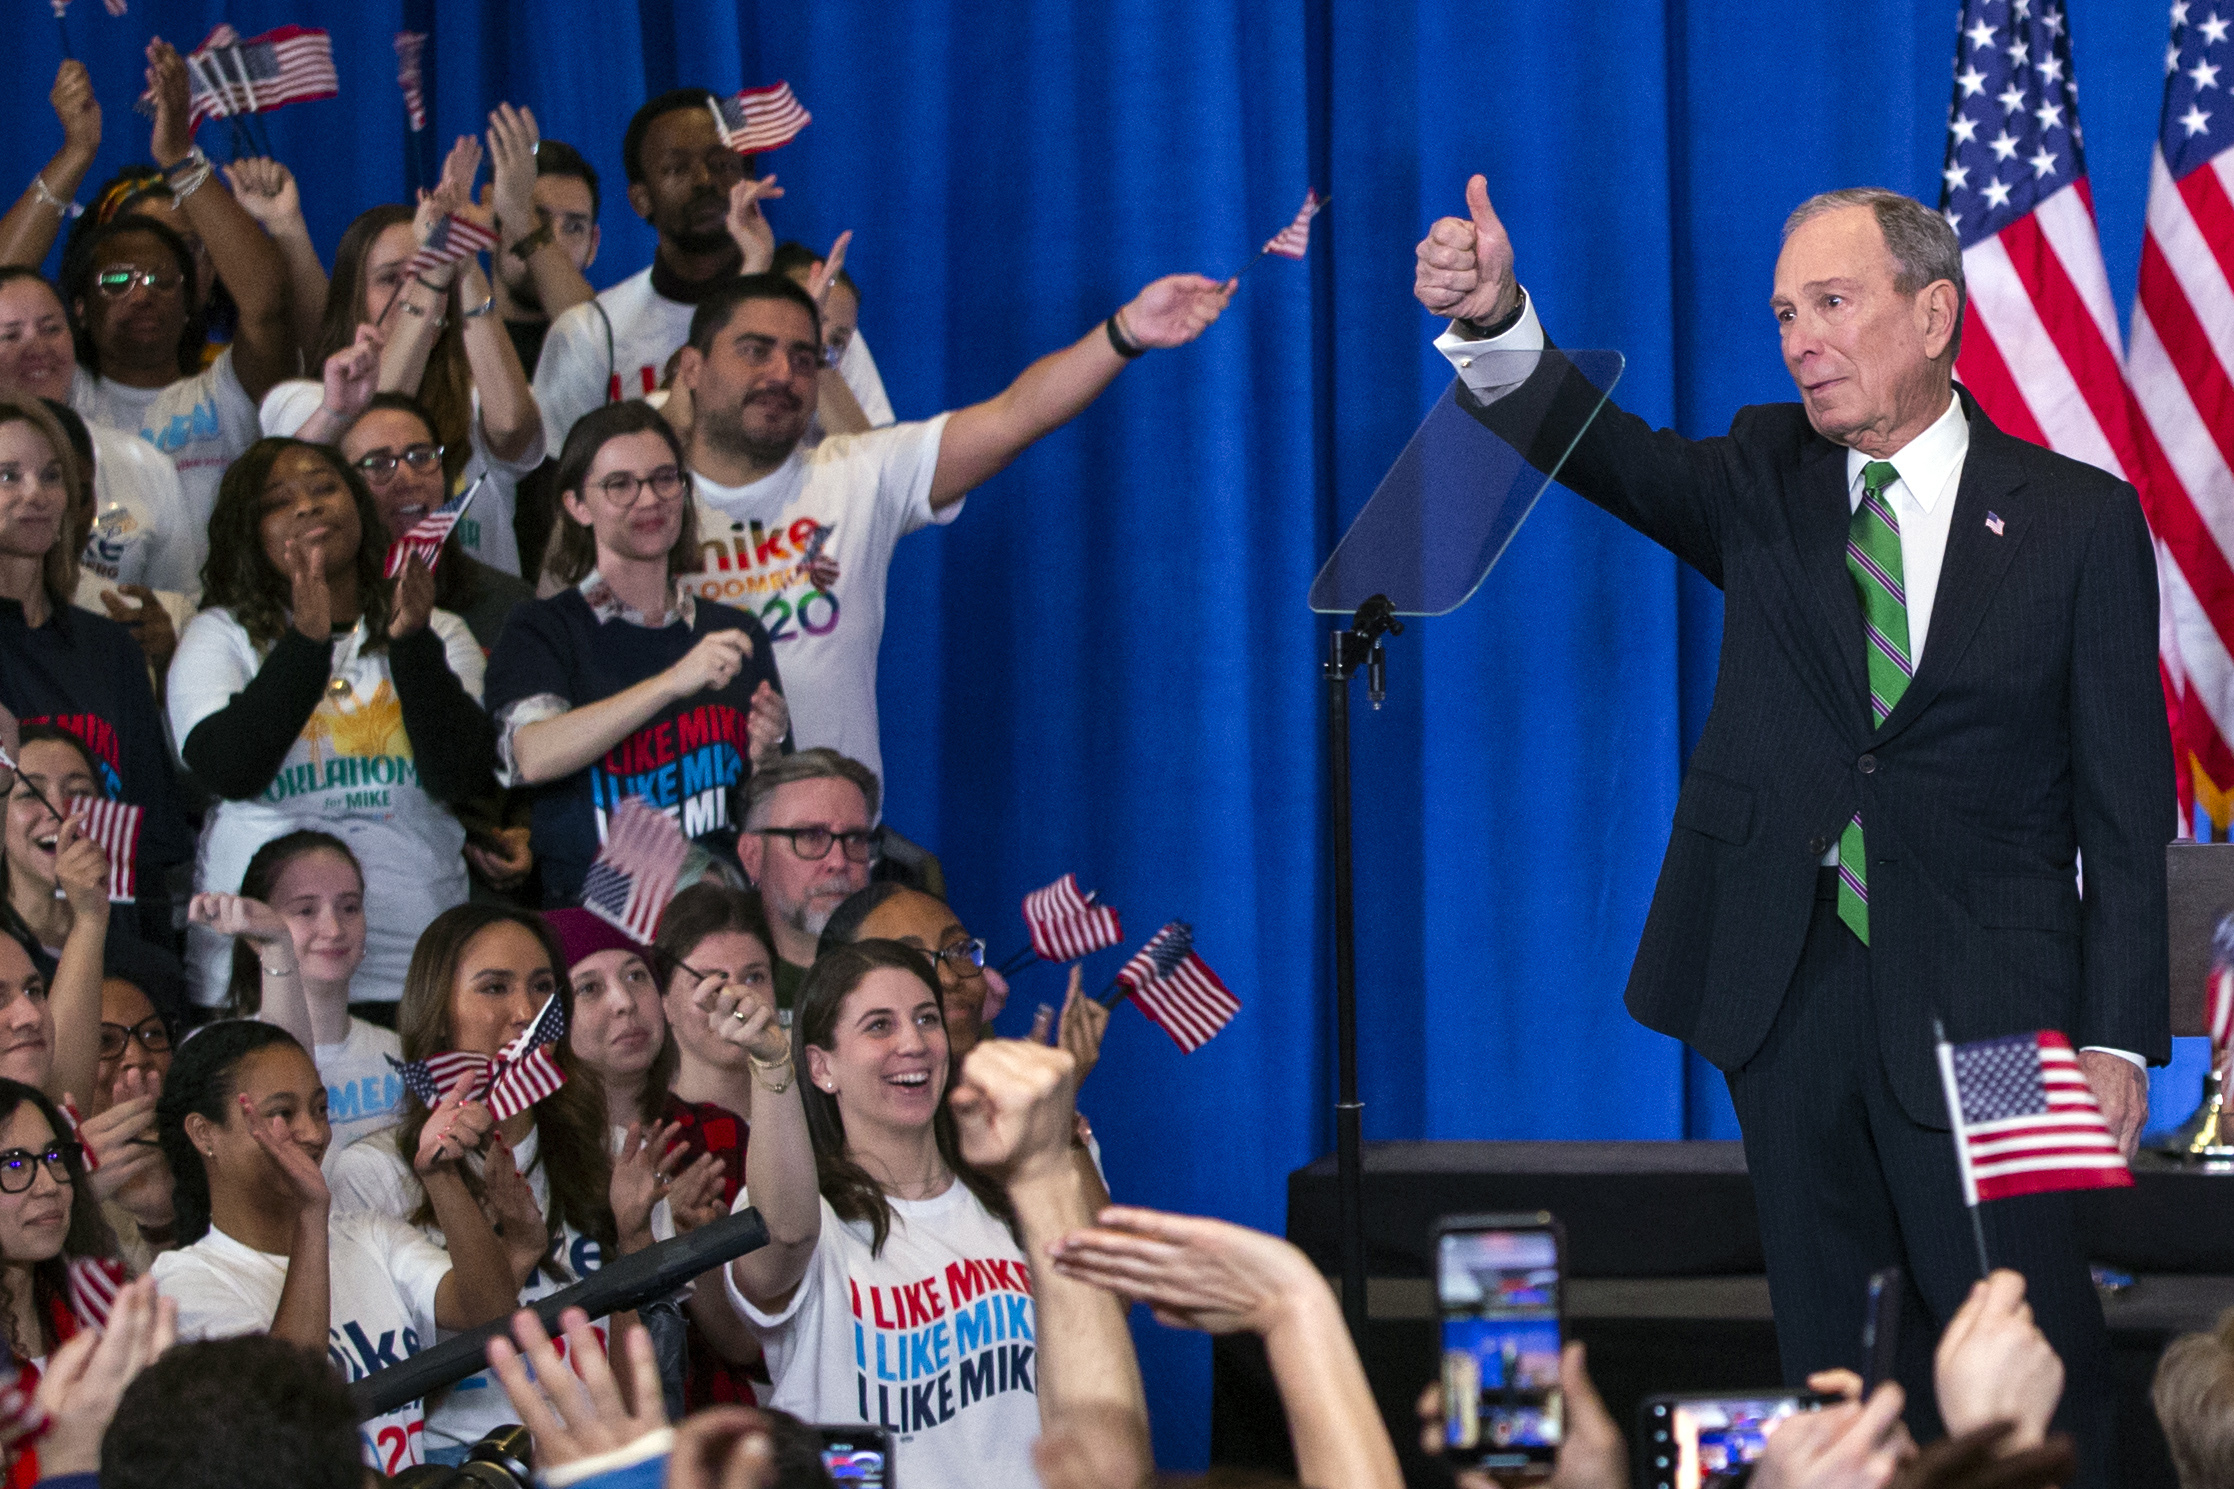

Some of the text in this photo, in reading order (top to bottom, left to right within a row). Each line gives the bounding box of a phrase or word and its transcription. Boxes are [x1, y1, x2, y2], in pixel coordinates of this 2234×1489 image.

[849, 1275, 863, 1321] I
[870, 1275, 946, 1330] LIKE
[855, 1294, 1036, 1382] I LIKE MIK
[858, 1344, 1037, 1433] I LIKE MIK
